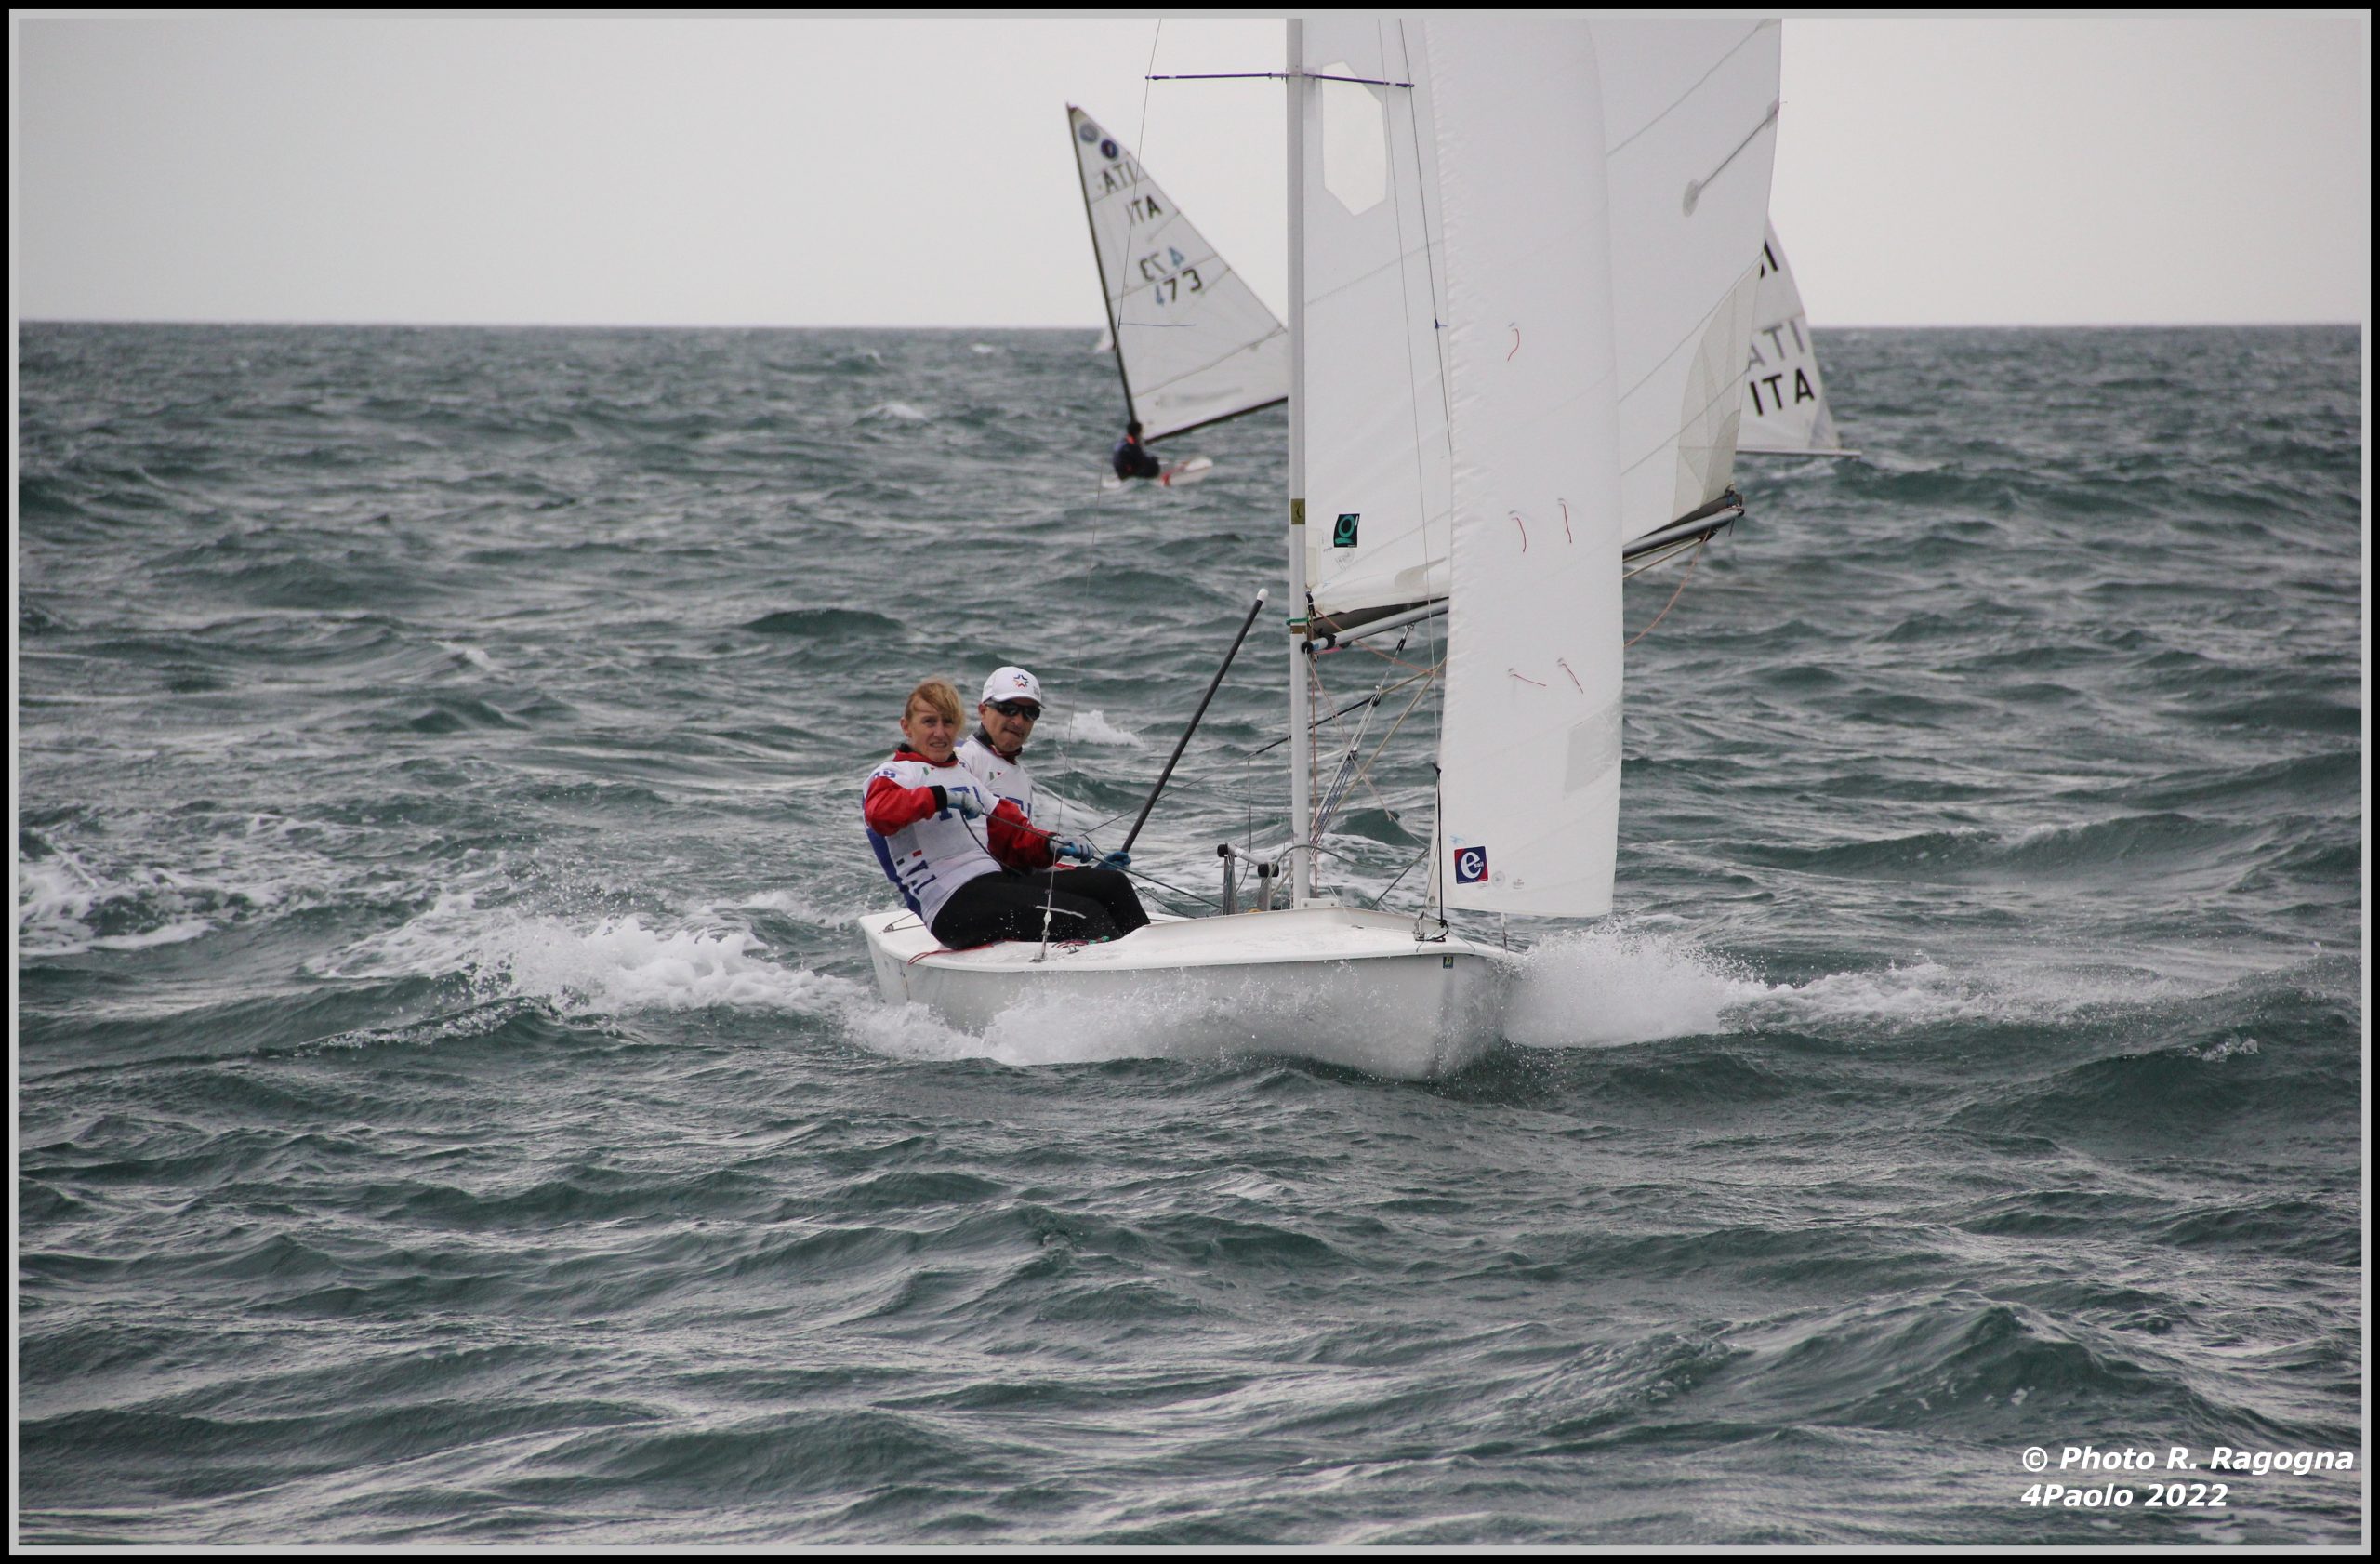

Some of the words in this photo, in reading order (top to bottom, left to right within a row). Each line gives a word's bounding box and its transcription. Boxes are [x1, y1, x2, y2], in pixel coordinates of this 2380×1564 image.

[1125, 196, 1162, 226] ITA
[1156, 269, 1202, 306] 473
[1749, 367, 1815, 417] ITA
